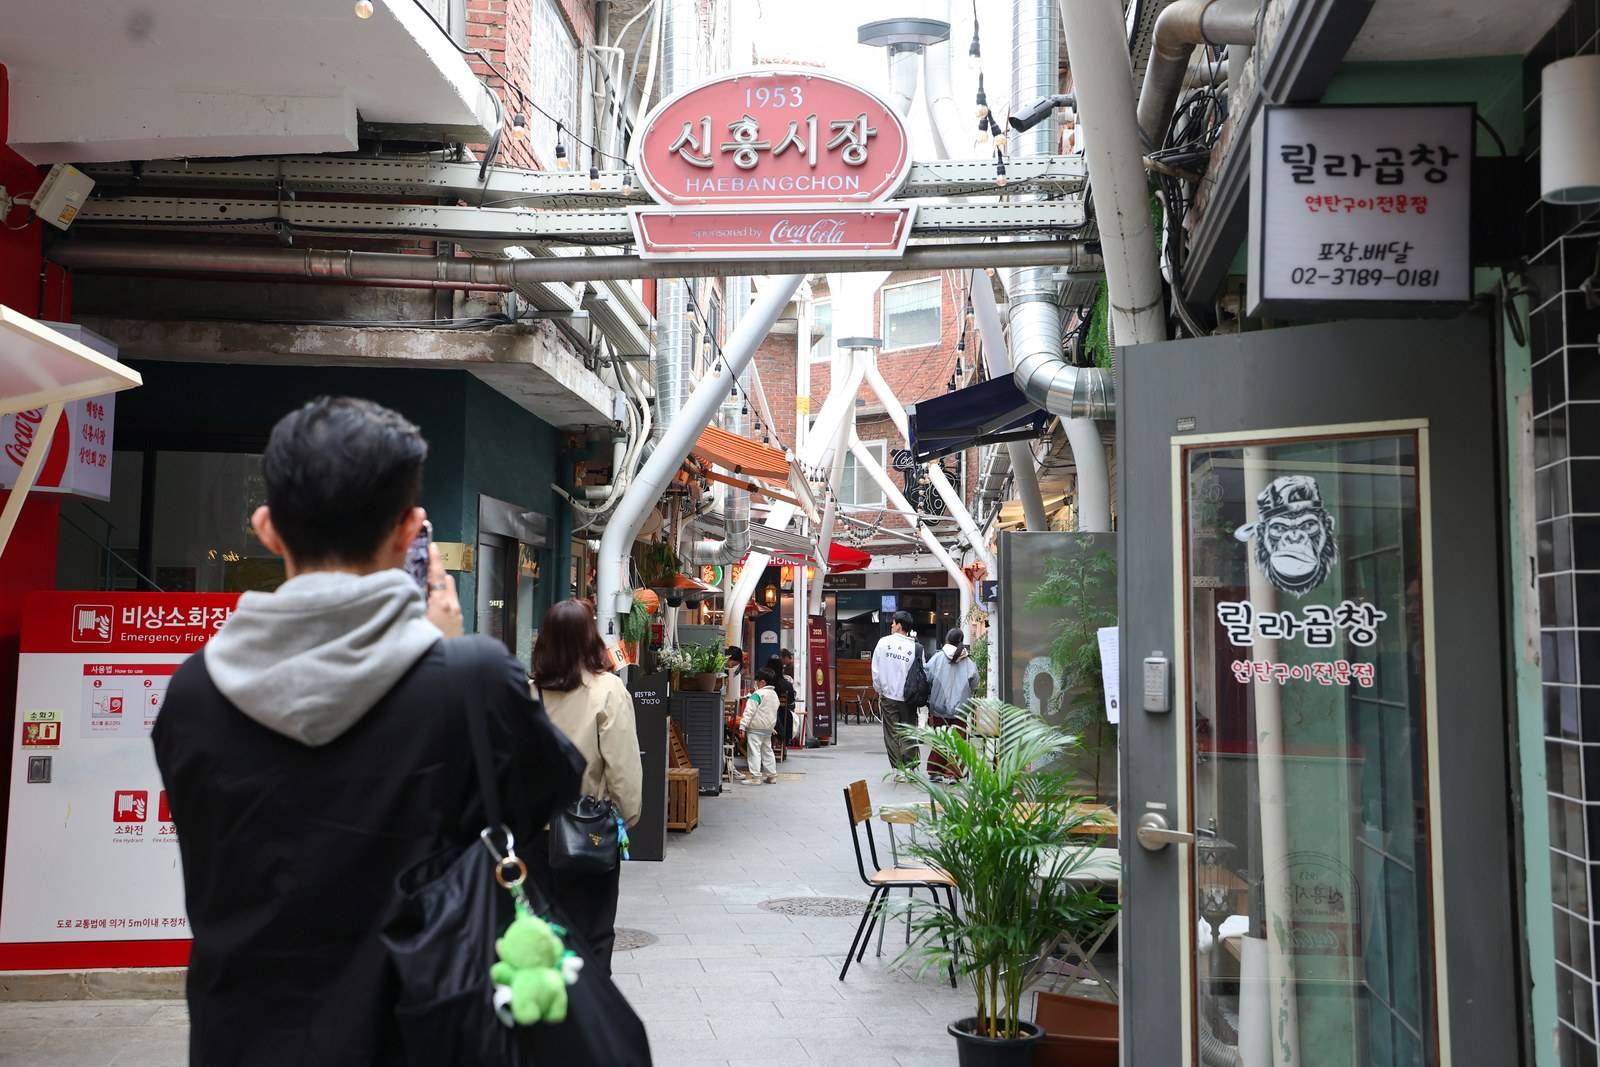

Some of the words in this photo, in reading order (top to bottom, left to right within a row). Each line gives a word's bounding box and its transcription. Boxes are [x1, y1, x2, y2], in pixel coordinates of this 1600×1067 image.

[745, 86, 803, 108] 1953
[668, 112, 878, 170] 신흥시장
[1280, 144, 1459, 185] 릴라곱창
[686, 175, 860, 192] HAEBANGCHON
[1304, 194, 1429, 214] 연탄구이전문점
[692, 228, 748, 240] sponsored
[749, 227, 762, 239] by
[769, 218, 847, 243] Coca-Cola
[1291, 267, 1440, 287] 02-3789-0181
[121, 605, 236, 630] 비상소화장
[1218, 600, 1386, 646] 릴라곱창
[121, 632, 181, 643] Emergency
[185, 632, 205, 642] Fire
[885, 653, 910, 663] STUDIO
[91, 665, 113, 674] 사용법
[1231, 660, 1375, 687] 연탄구이전문점
[114, 824, 143, 835] 소화전
[56, 919, 73, 929] 도로
[74, 919, 107, 929] 교통법에
[109, 918, 126, 928] 의거
[128, 918, 159, 928] 5m이내
[161, 917, 186, 928] 주정차
